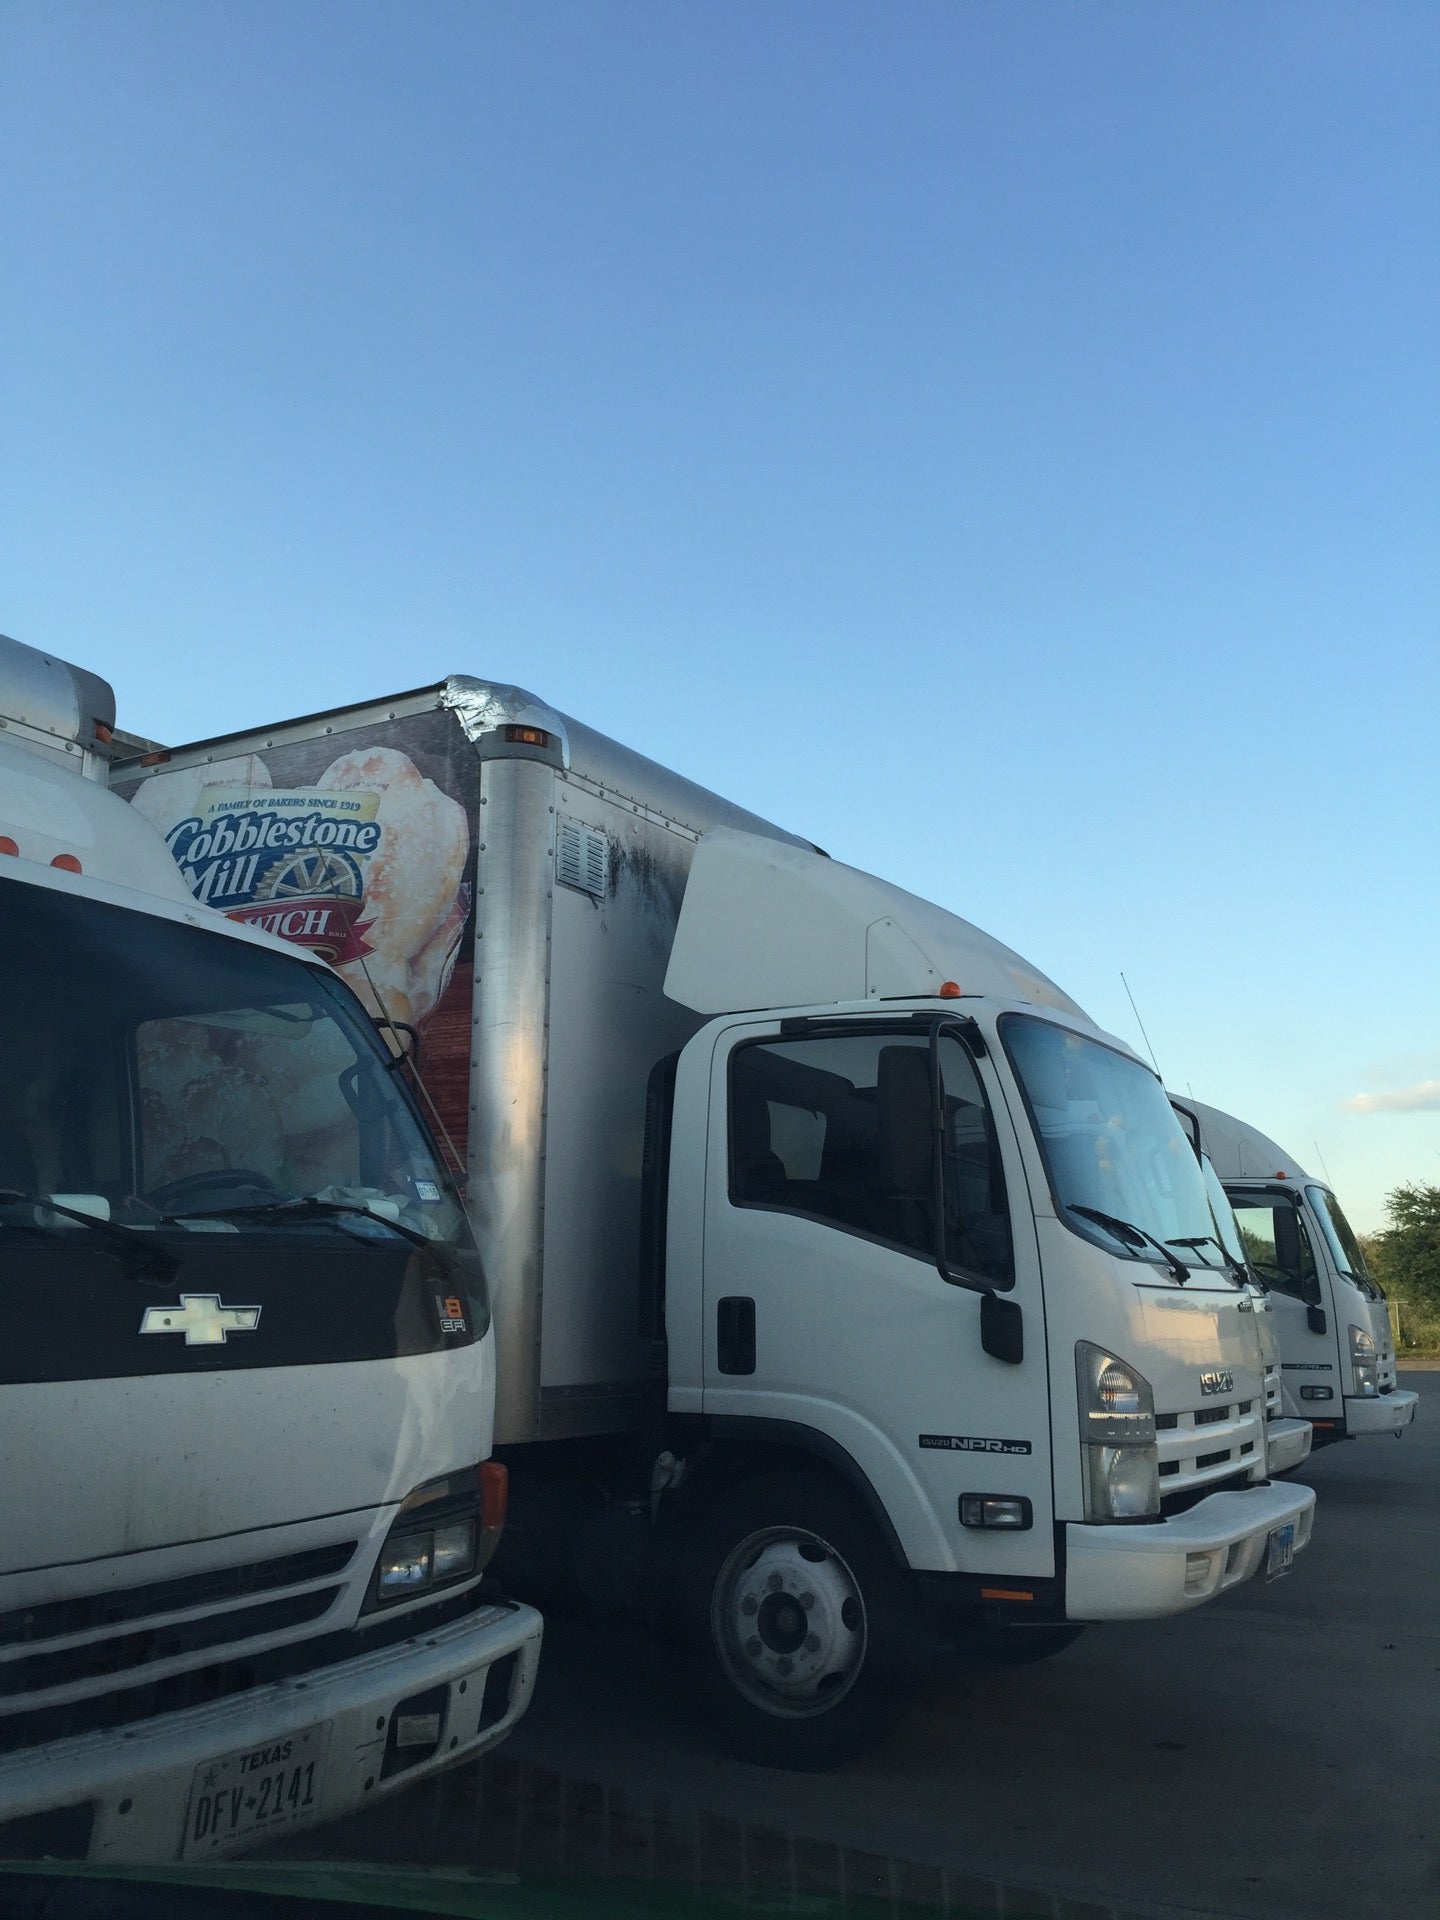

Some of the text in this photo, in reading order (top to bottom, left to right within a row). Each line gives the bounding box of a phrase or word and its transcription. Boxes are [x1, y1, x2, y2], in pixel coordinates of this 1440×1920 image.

[208, 797, 361, 813] A FAMILY OF BAKERS SINCE 1919
[166, 813, 379, 867] Cobblestone
[183, 852, 260, 904] Mill
[1200, 1370, 1233, 1396] ISUZU
[922, 1438, 950, 1447] ISUZU
[950, 1437, 1003, 1452] NPR
[240, 1740, 293, 1774] TEXAS
